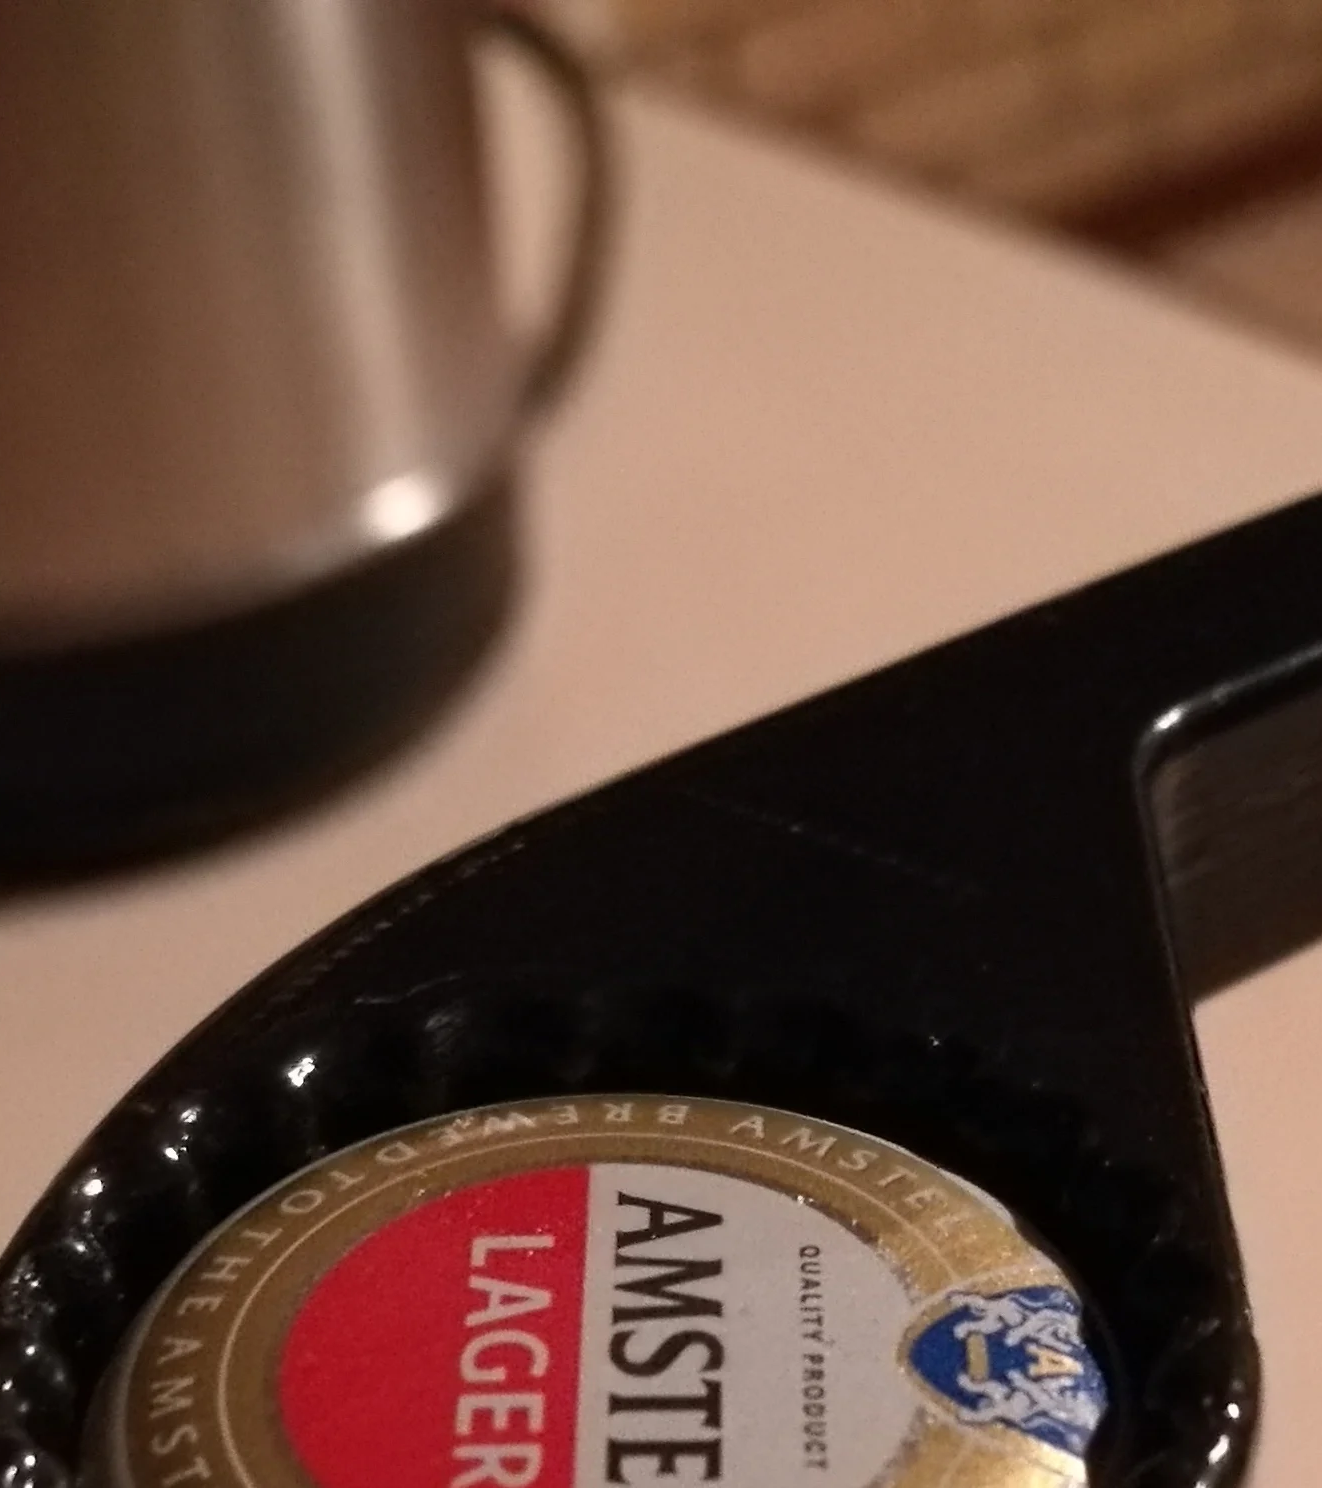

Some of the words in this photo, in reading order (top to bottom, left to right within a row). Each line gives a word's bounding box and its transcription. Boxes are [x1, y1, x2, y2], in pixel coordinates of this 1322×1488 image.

[279, 1170, 366, 1215] TO
[178, 1226, 284, 1316] THE
[798, 1243, 825, 1342] QUALITY
[801, 1353, 828, 1470] PRODUCT
